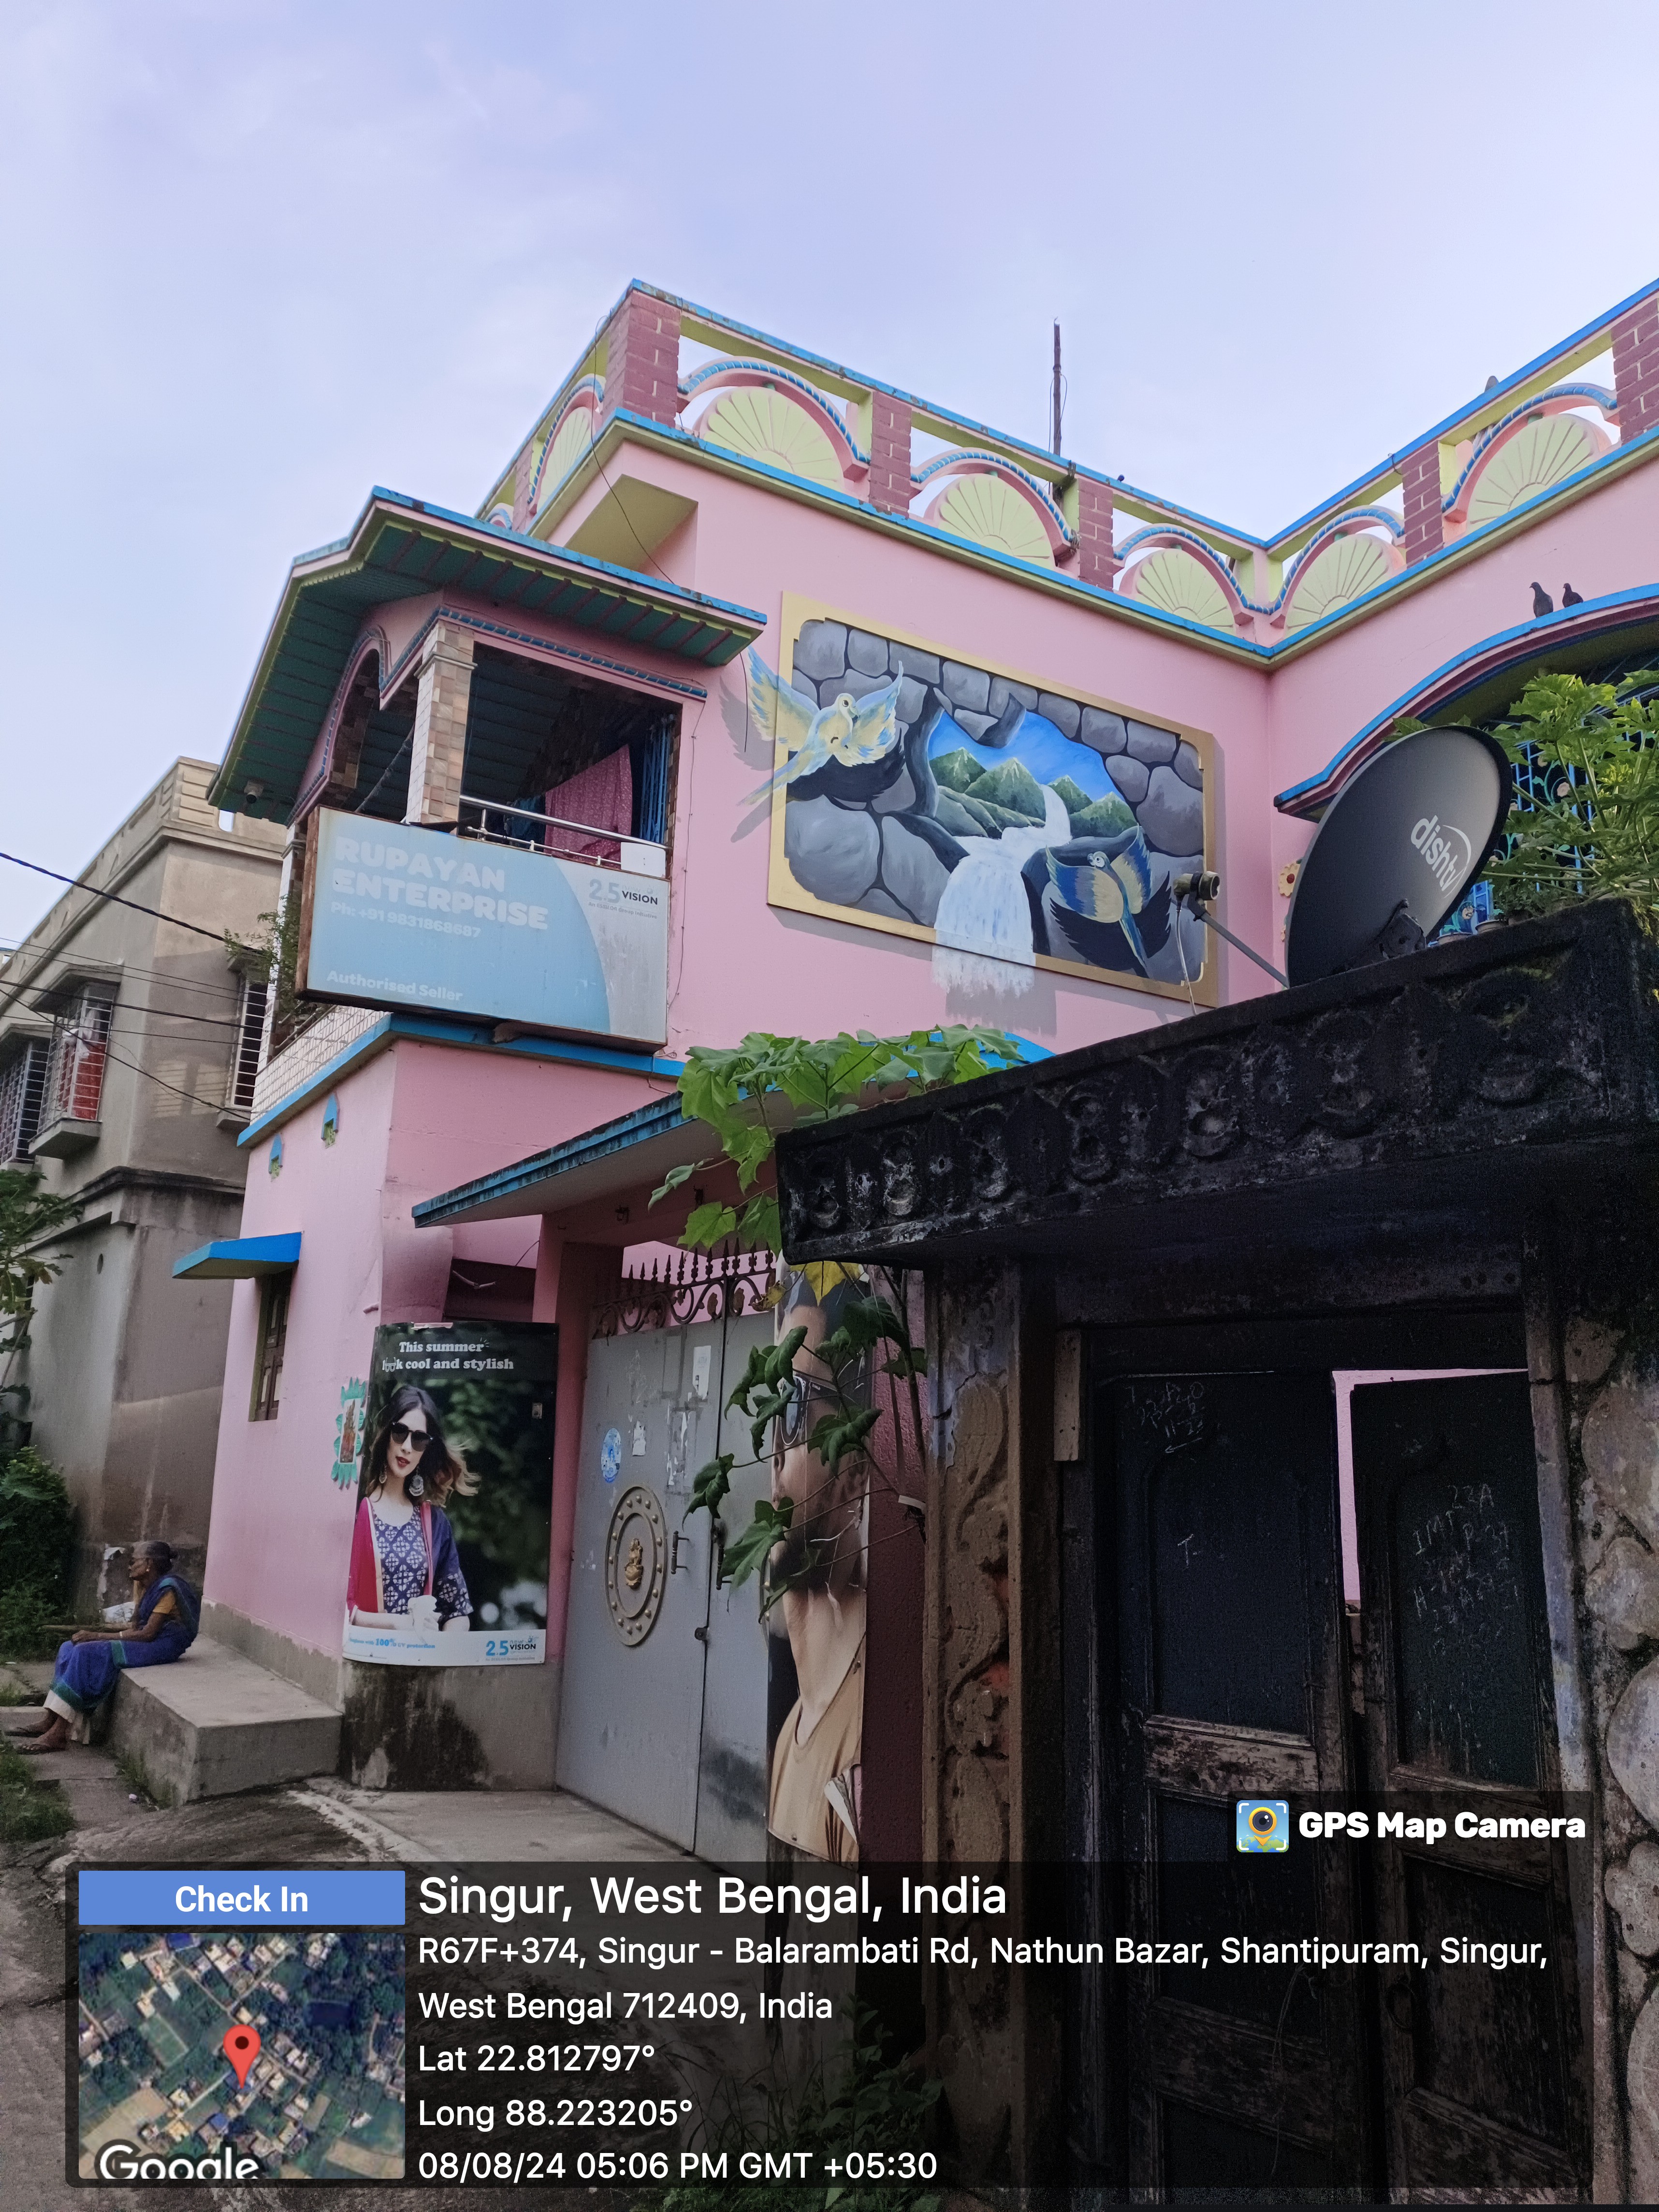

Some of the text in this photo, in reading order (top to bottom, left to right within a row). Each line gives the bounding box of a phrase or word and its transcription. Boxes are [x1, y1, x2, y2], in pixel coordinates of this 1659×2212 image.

[335, 836, 505, 892] RUPAYAN
[332, 868, 549, 930] ENTERPRISE
[589, 878, 658, 905] 2.5 VISION
[331, 902, 356, 917] Ph:
[358, 907, 384, 921] +91
[635, 911, 658, 919] Initiative
[326, 970, 464, 1001] Authorised Seller
[399, 1341, 484, 1353] This summer
[405, 1358, 431, 1369] cool
[433, 1358, 460, 1369] and
[463, 1358, 514, 1371] stylish
[485, 1640, 509, 1656] 2.5
